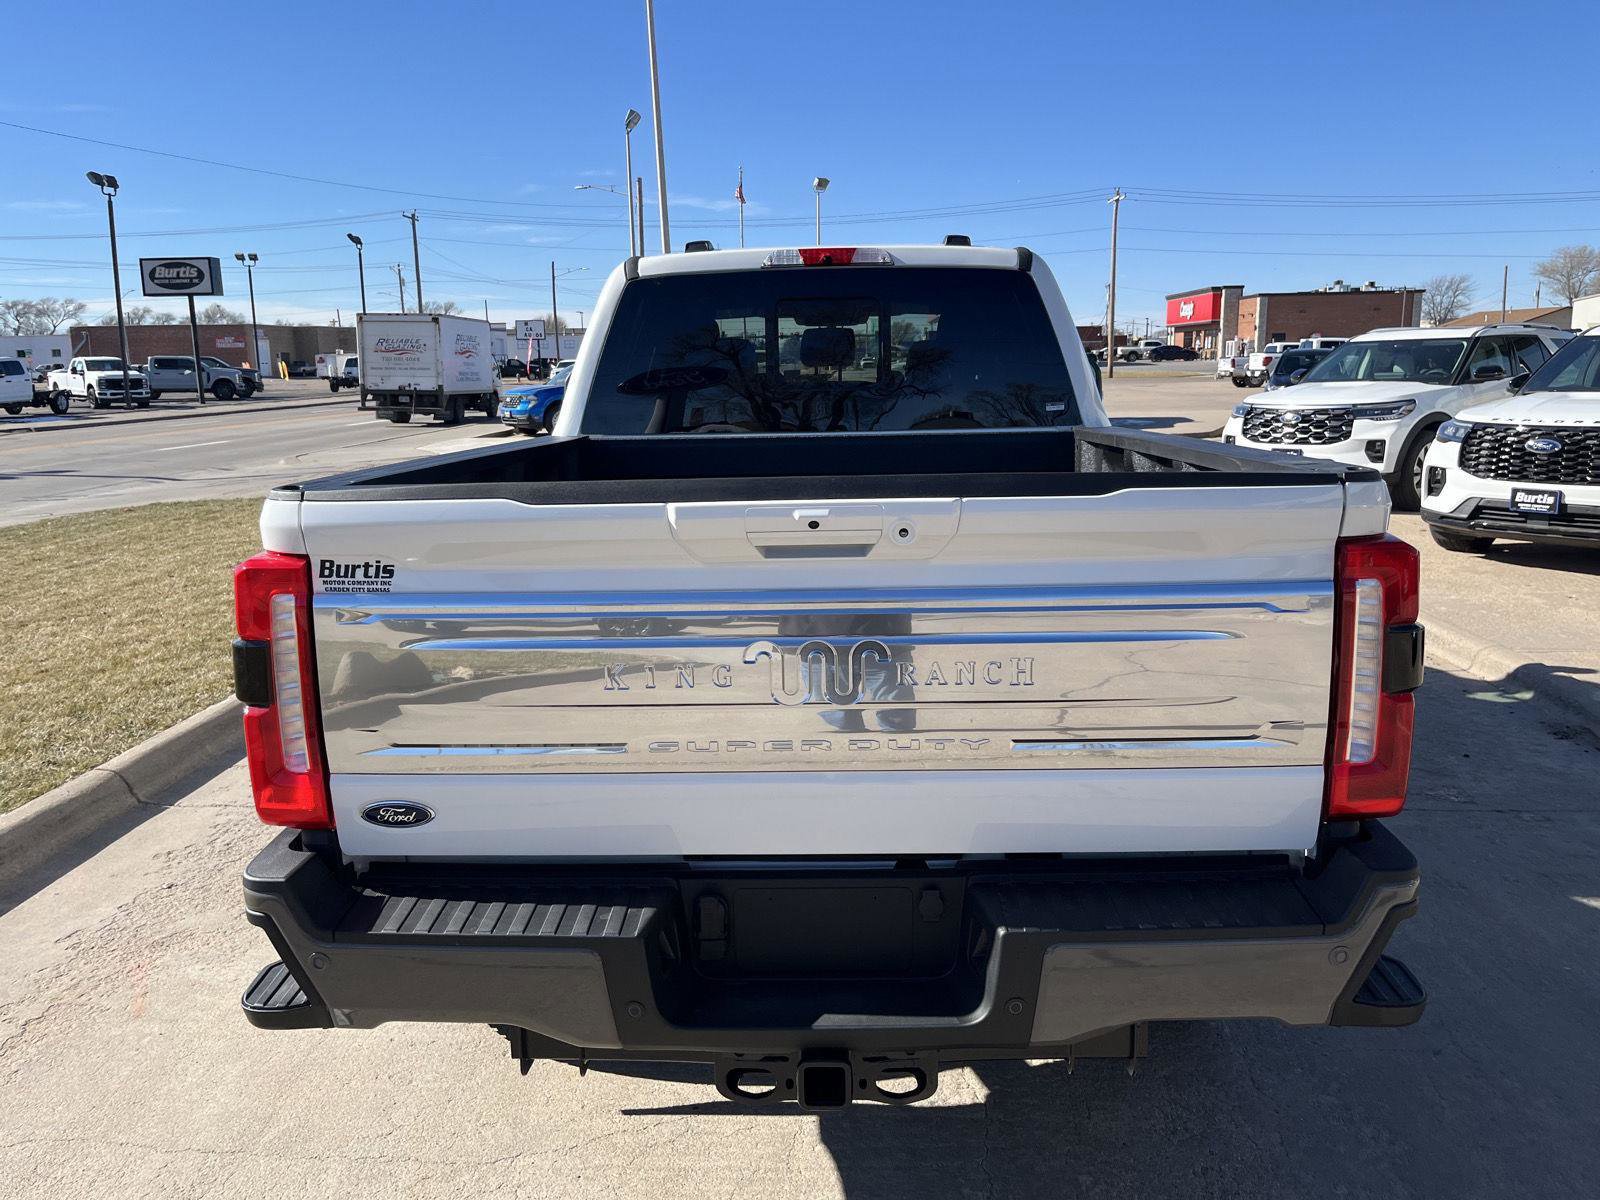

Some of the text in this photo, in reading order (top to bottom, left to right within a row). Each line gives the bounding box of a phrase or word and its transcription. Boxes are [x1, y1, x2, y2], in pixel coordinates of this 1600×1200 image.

[154, 266, 198, 278] Burtis
[376, 338, 423, 346] RELIABLE
[1515, 492, 1555, 504] Burtis
[319, 559, 395, 578] Burtis
[603, 657, 1036, 691] KING RANCH
[648, 738, 991, 752] SUPER DUTY
[377, 807, 417, 822] Ford
